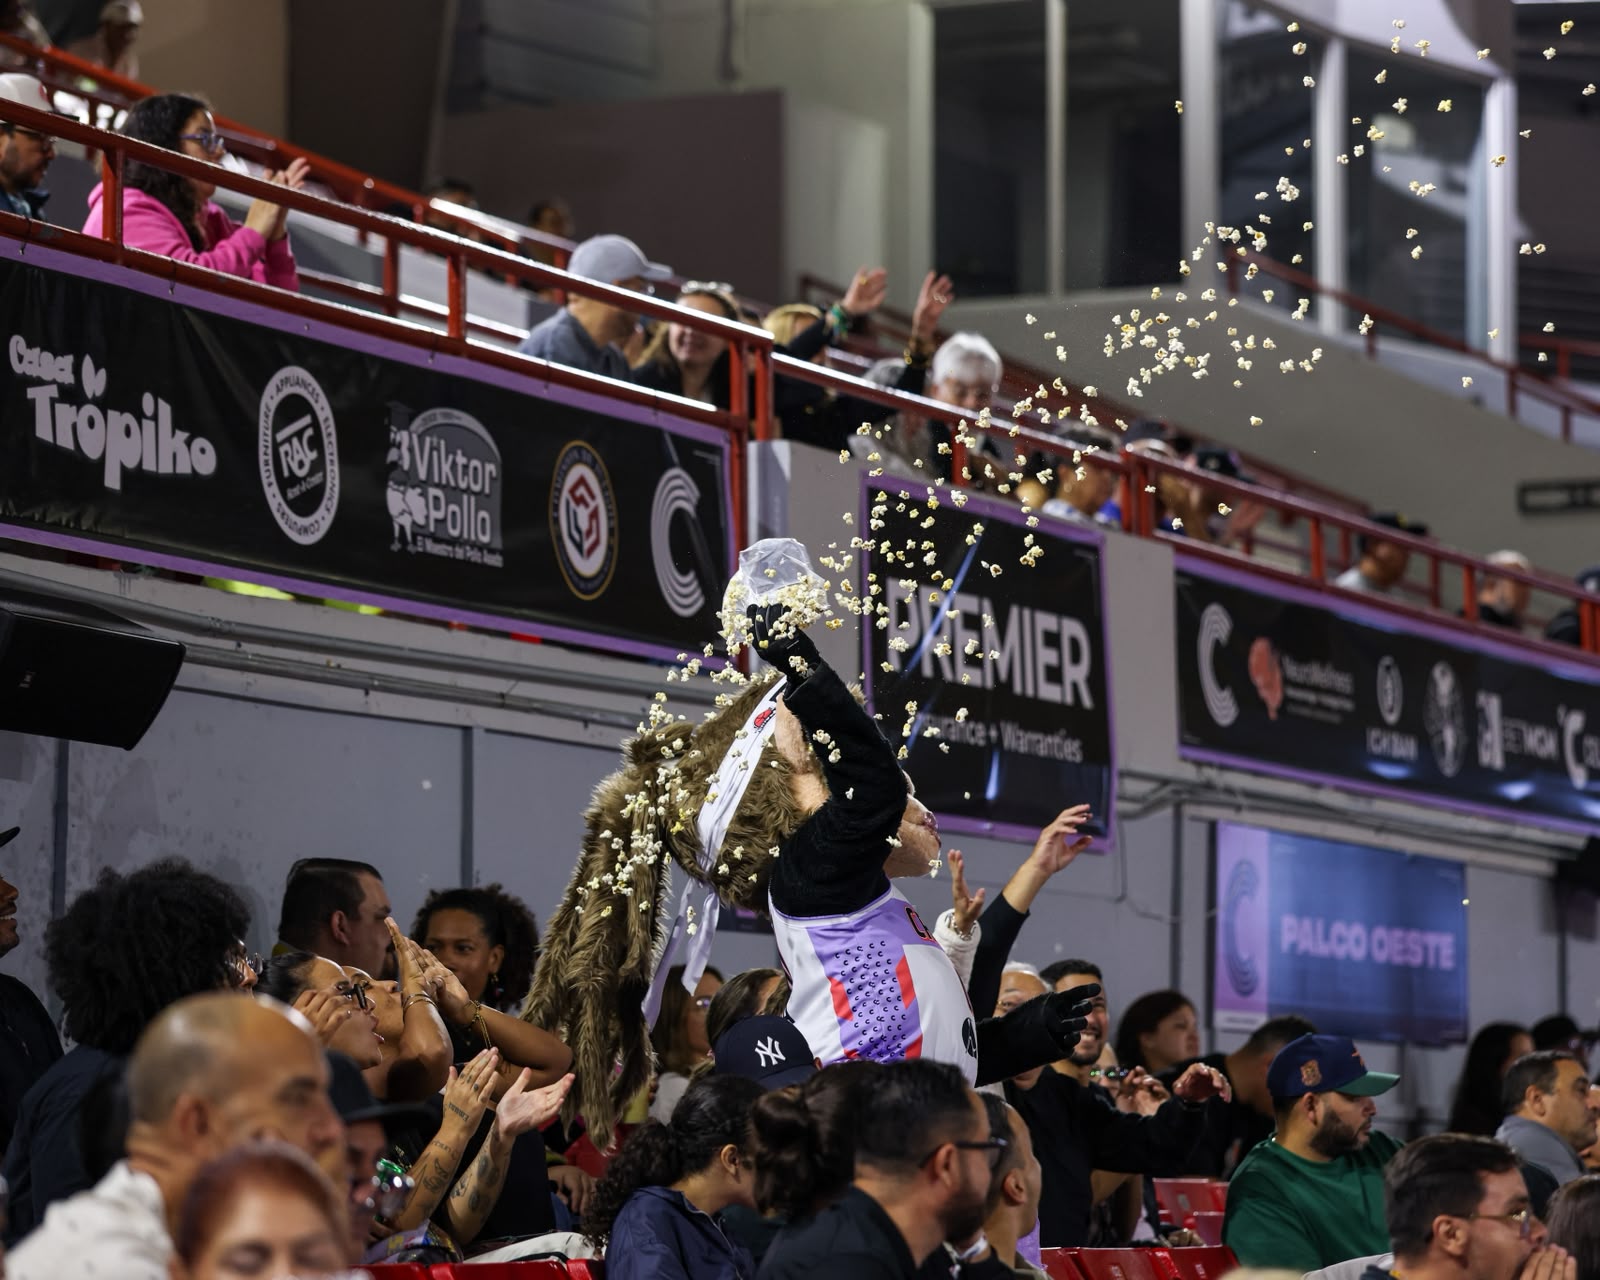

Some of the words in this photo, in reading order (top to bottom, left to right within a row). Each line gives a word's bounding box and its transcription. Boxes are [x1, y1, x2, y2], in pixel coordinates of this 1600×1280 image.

[9, 334, 75, 385] Casa
[275, 375, 320, 404] APPLIANCES
[26, 383, 217, 491] Tropiko
[262, 402, 274, 488] FURNITURE
[279, 426, 318, 478] RAC
[323, 416, 337, 514] ELECTRONICS
[410, 432, 497, 496] Viktor
[276, 502, 320, 537] COMPUTERS
[427, 486, 492, 544] Pollo
[885, 576, 1094, 710] PREMIER
[1000, 720, 1084, 764] Warranties
[1280, 912, 1367, 961] PALCO
[1370, 924, 1457, 972] OESTE
[755, 1035, 786, 1067] NY
